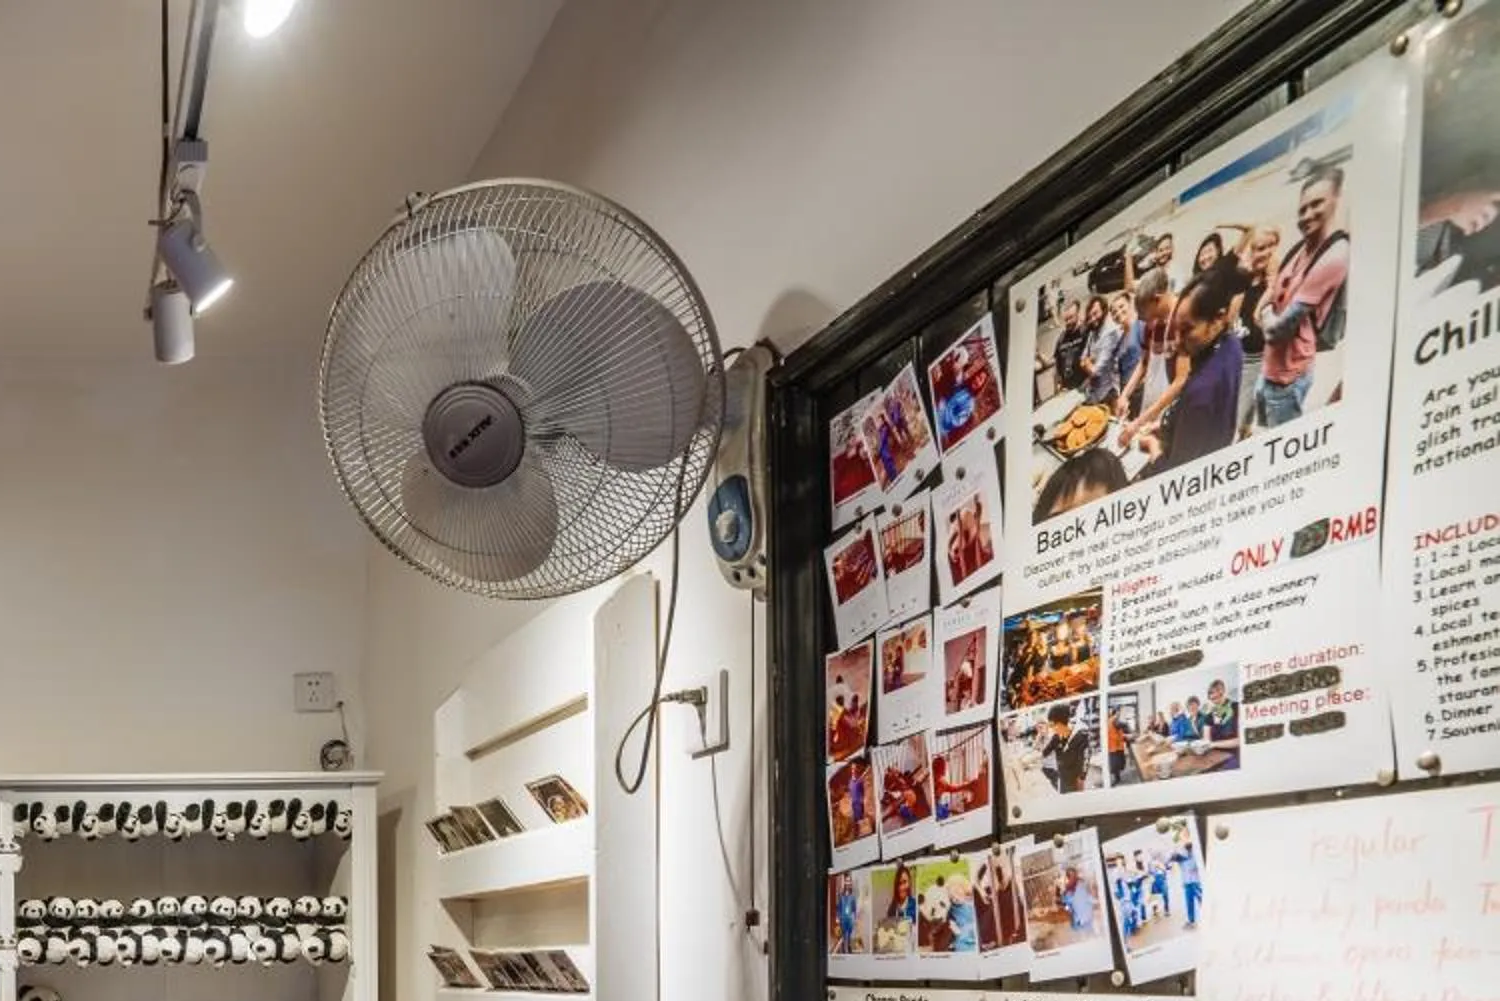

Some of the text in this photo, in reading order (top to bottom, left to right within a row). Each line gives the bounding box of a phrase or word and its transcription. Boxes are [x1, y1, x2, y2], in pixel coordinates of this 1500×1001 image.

[1419, 403, 1462, 430] Join
[1263, 452, 1341, 490] interesting
[1037, 422, 1334, 555] Back Alley Walker Tour
[1230, 506, 1378, 577] ONLY RMB
[1288, 642, 1365, 670] duration:
[1245, 698, 1309, 721] Meeting
